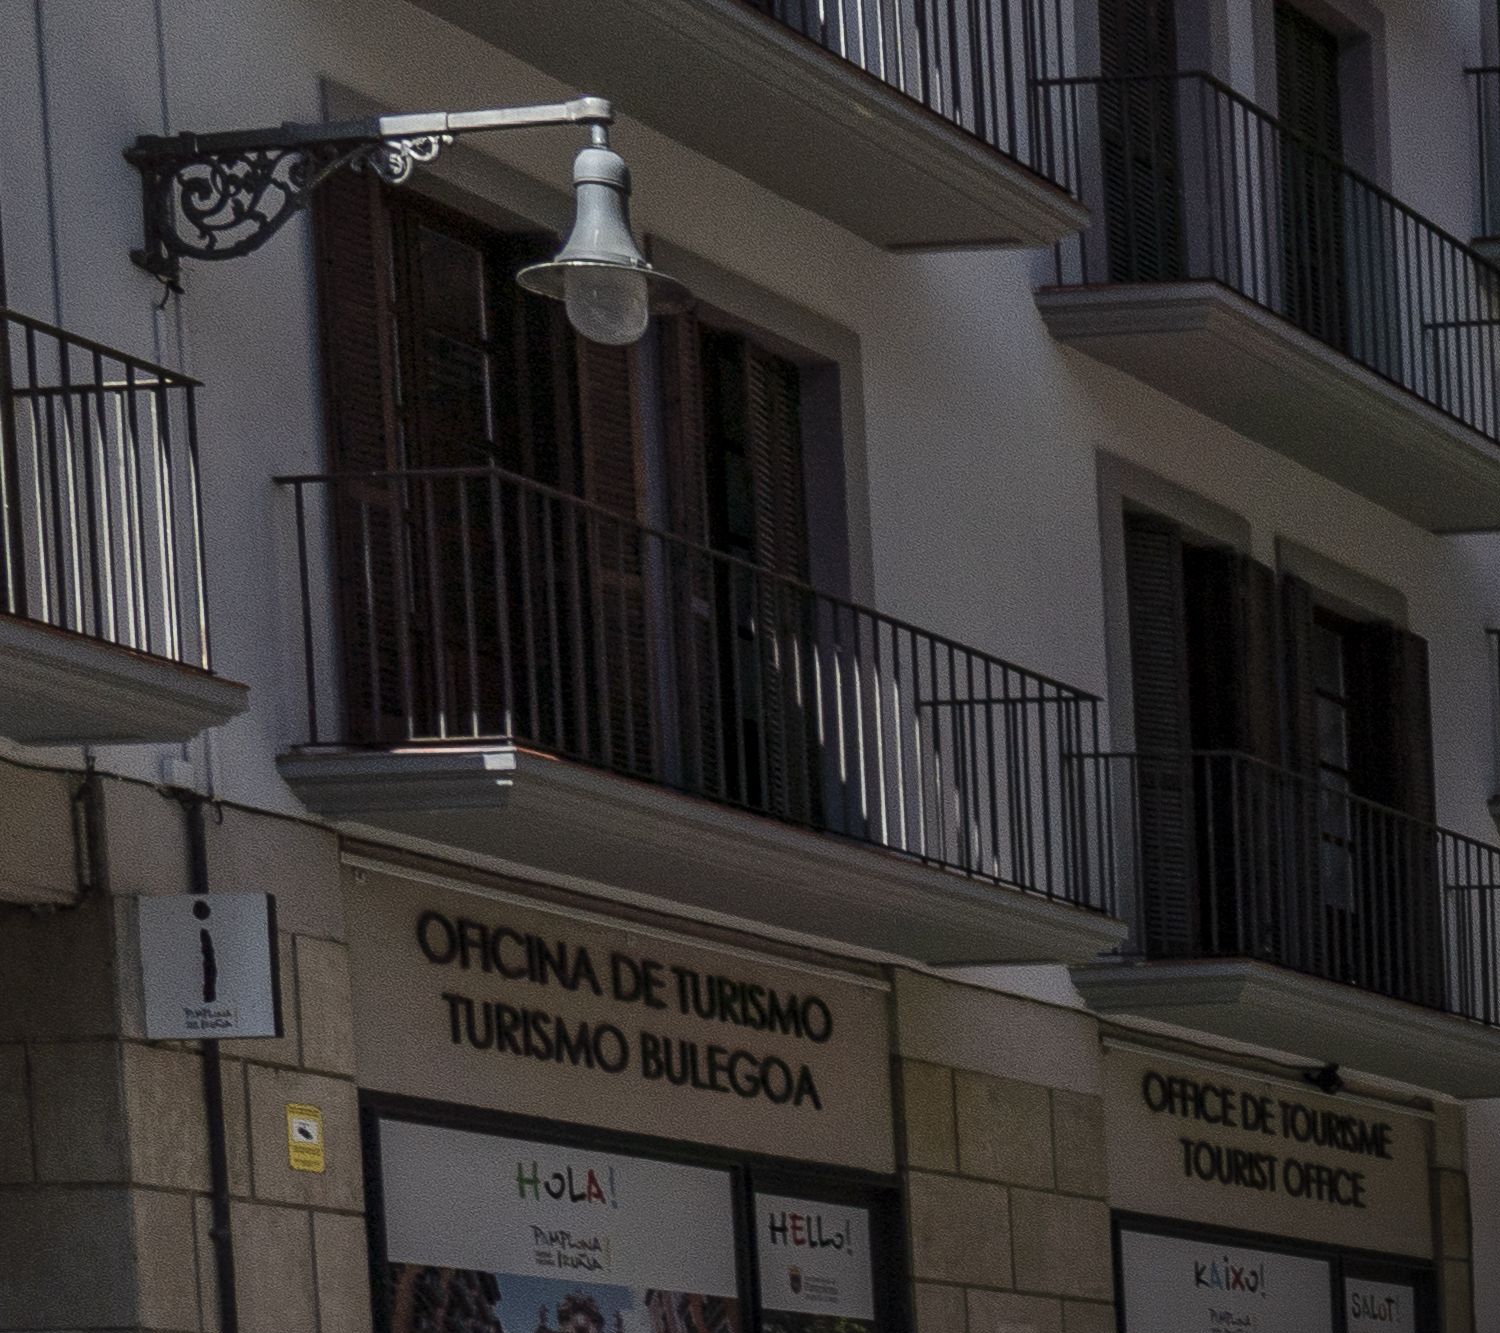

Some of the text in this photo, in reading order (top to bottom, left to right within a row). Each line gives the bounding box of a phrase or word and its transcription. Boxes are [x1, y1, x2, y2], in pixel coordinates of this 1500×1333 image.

[417, 910, 833, 1043] OFICINA DE TURISMO
[441, 992, 822, 1111] TURISMO BULEGOA
[1142, 1071, 1394, 1160] OFFICE DE TOURISME
[1179, 1137, 1367, 1208] TOURIST OFFICE
